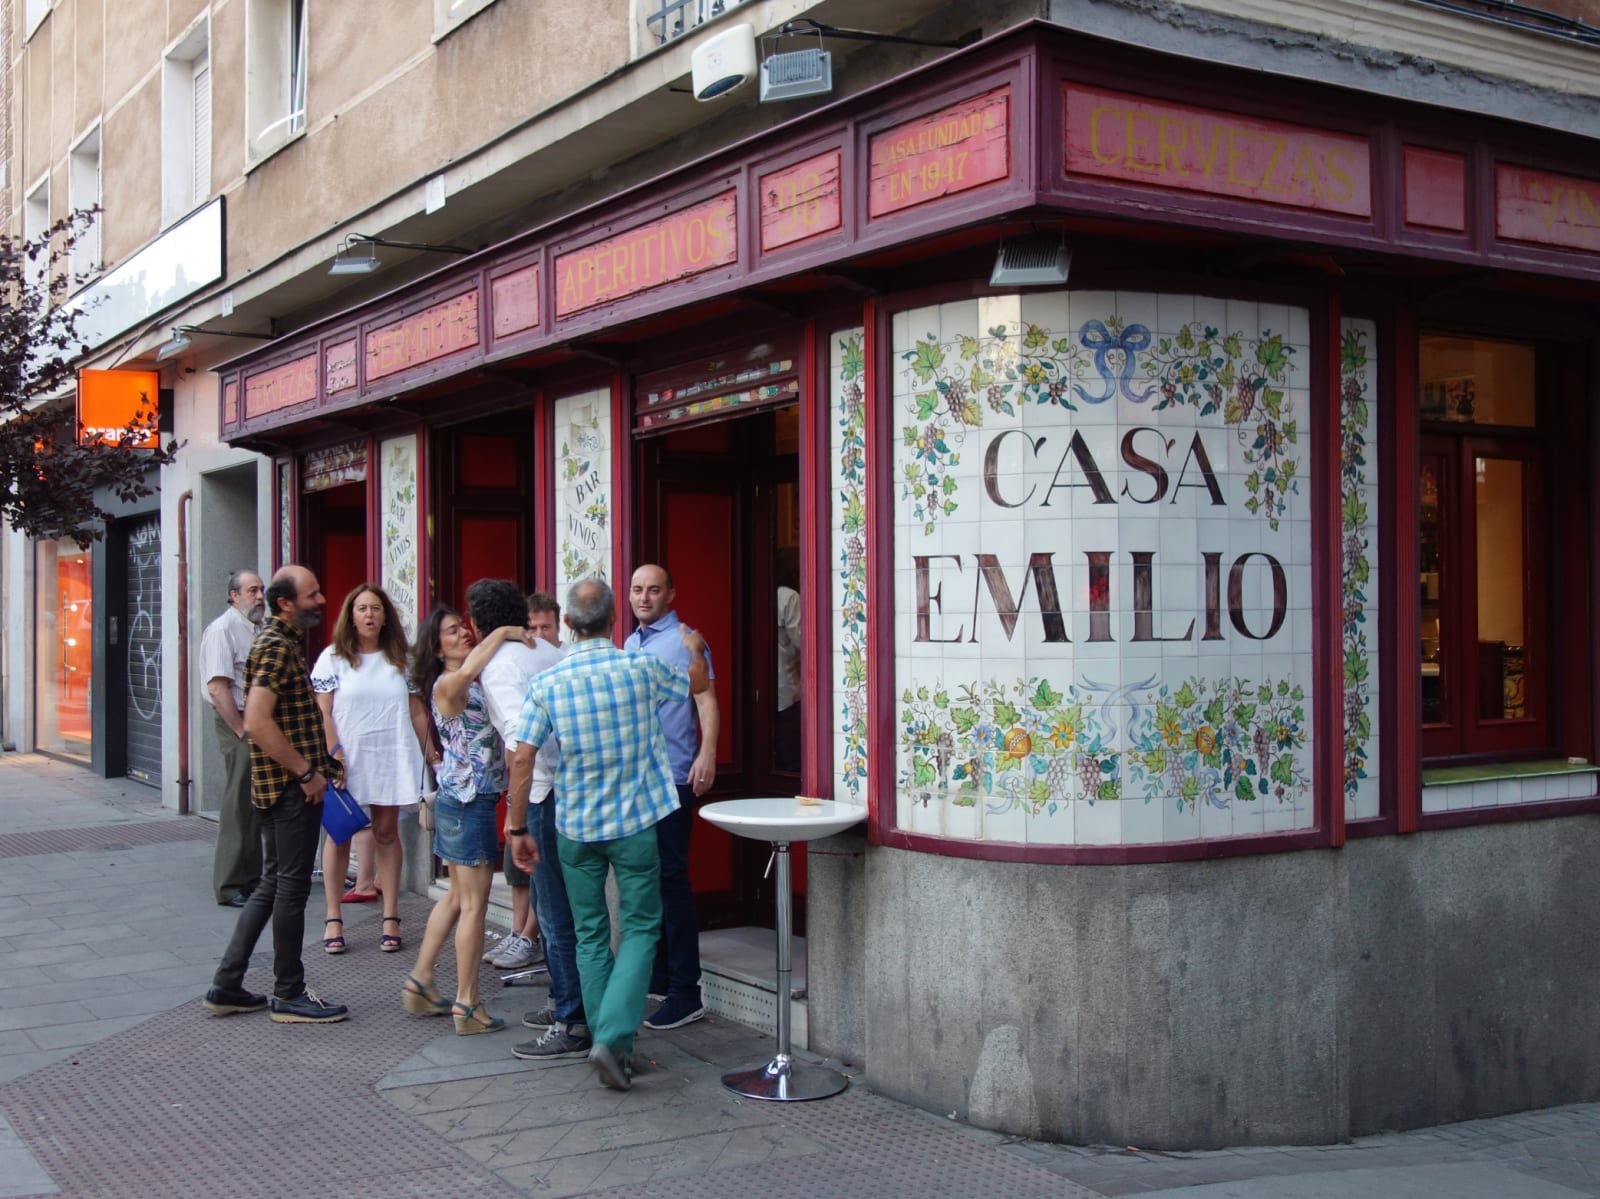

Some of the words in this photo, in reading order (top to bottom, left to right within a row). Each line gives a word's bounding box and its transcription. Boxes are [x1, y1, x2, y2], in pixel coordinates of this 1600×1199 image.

[878, 137, 915, 169] CASA
[919, 111, 994, 152] FUNDADA
[1090, 105, 1353, 202] CERVEZAS
[776, 172, 821, 236] 98
[889, 171, 912, 203] EN
[920, 151, 968, 192] 1947
[561, 207, 730, 306] APERITIVOS
[575, 469, 600, 504] BAR
[983, 427, 1227, 508] CASA
[390, 498, 406, 525] BAR
[568, 513, 597, 551] VINOS
[388, 535, 411, 565] VINOS
[911, 551, 1288, 643] EMILIO
